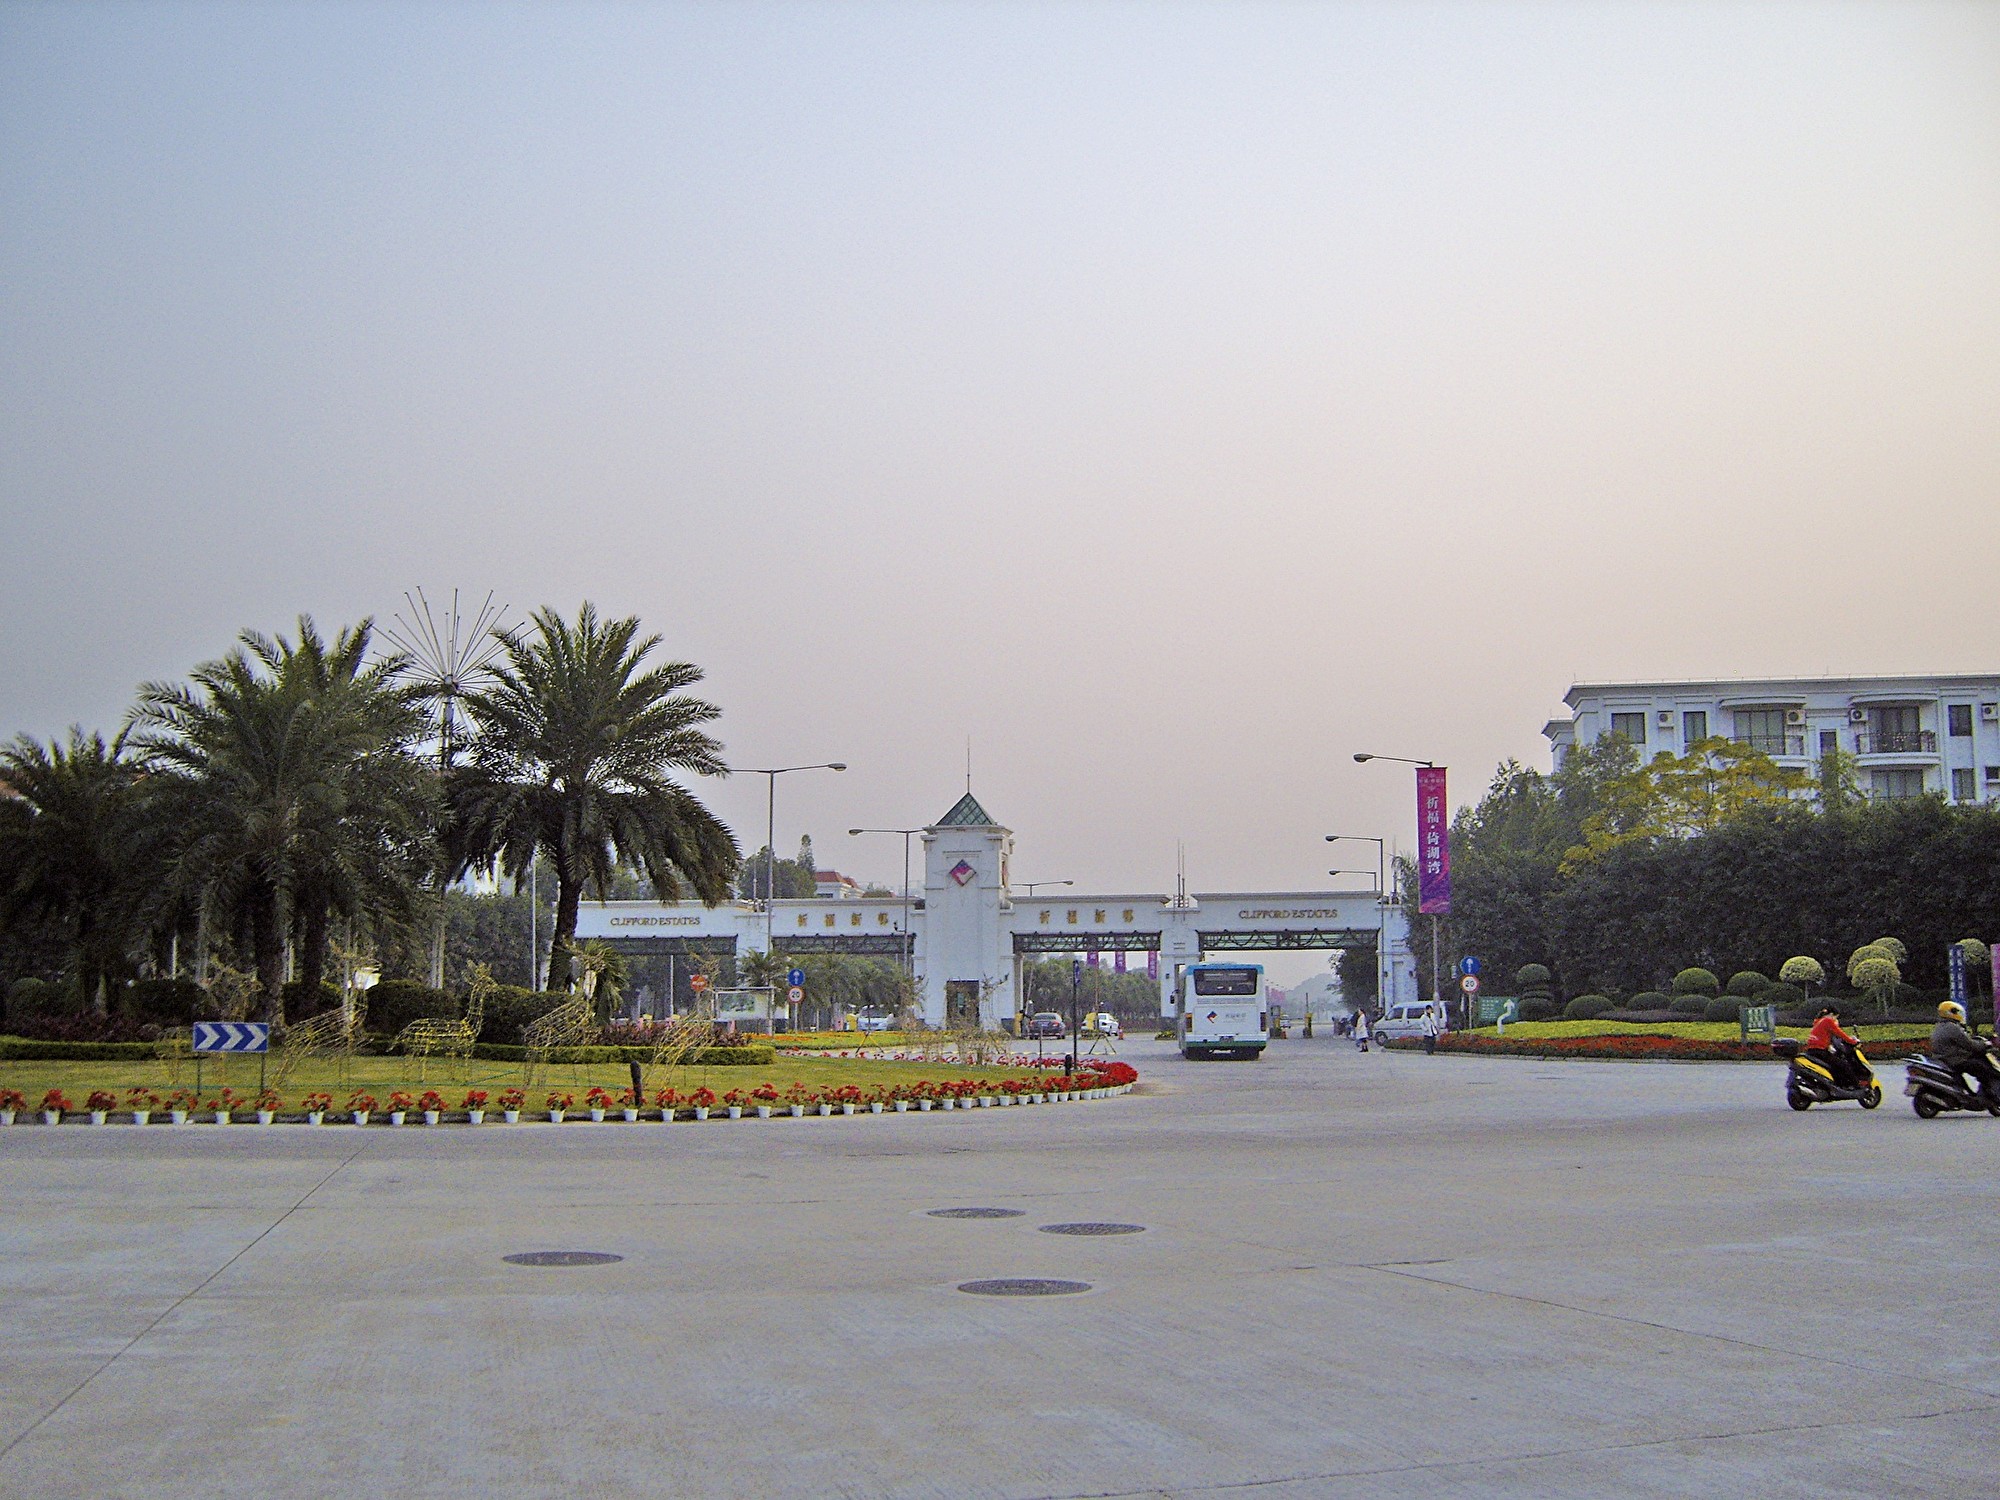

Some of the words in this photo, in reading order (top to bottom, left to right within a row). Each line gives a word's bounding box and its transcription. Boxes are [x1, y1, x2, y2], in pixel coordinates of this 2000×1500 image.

[1239, 910, 1290, 919] CLIFFORD
[1292, 909, 1337, 918] ESTATES
[610, 917, 658, 926] CLIFFORD
[659, 917, 701, 926] ESTATES
